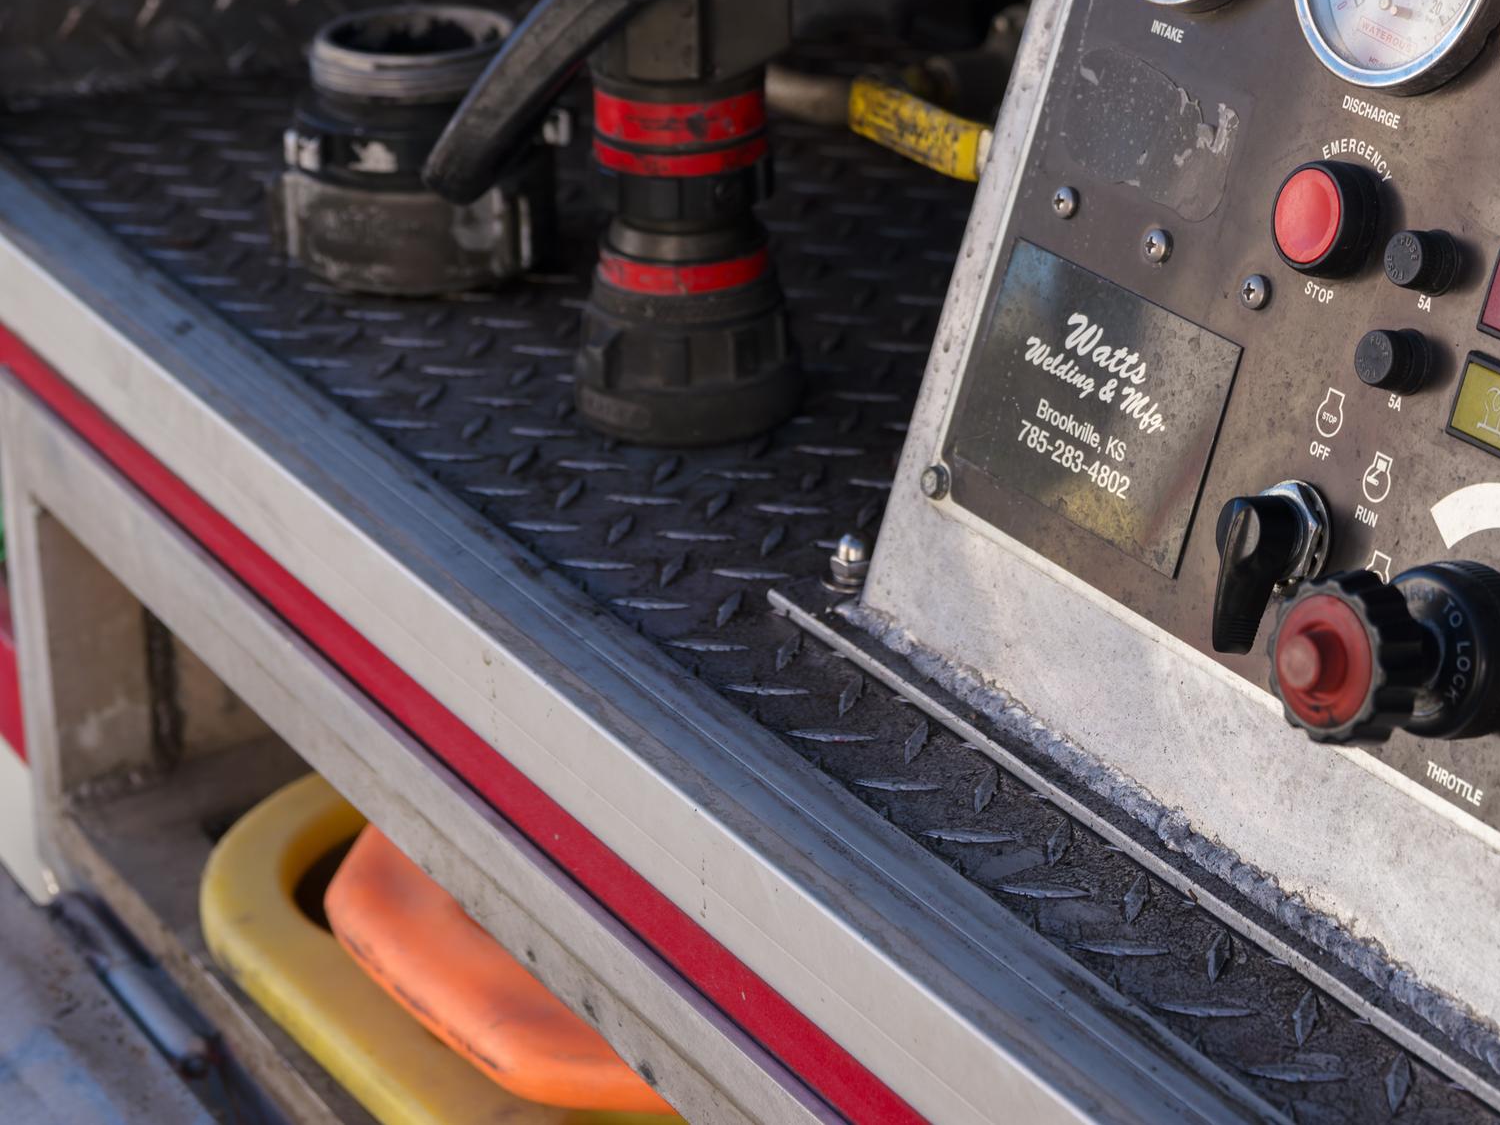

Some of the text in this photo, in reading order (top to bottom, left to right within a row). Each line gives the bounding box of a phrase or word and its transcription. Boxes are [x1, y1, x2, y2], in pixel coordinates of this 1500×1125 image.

[1151, 19, 1184, 43] INTAKE
[1361, 21, 1415, 53] WATEROUS
[1342, 94, 1400, 129] DISCHARGE
[1321, 138, 1393, 183] EMERGENCY
[1400, 235, 1418, 260] FUSE
[1304, 281, 1334, 305] STOP
[1417, 295, 1431, 313] 5A
[1065, 312, 1147, 385] Watts
[1024, 336, 1166, 434] Welding & Mfg.
[1320, 410, 1338, 424] STOP
[1388, 394, 1402, 412] 5A
[1036, 398, 1127, 462] Brookville, KS
[1017, 420, 1131, 499] 785-283-4802
[1309, 440, 1331, 461] OFF
[1355, 504, 1378, 527] RUN
[1442, 596, 1463, 628] TO
[1444, 640, 1472, 706] LOCK
[1426, 760, 1483, 806] THROTTLE
